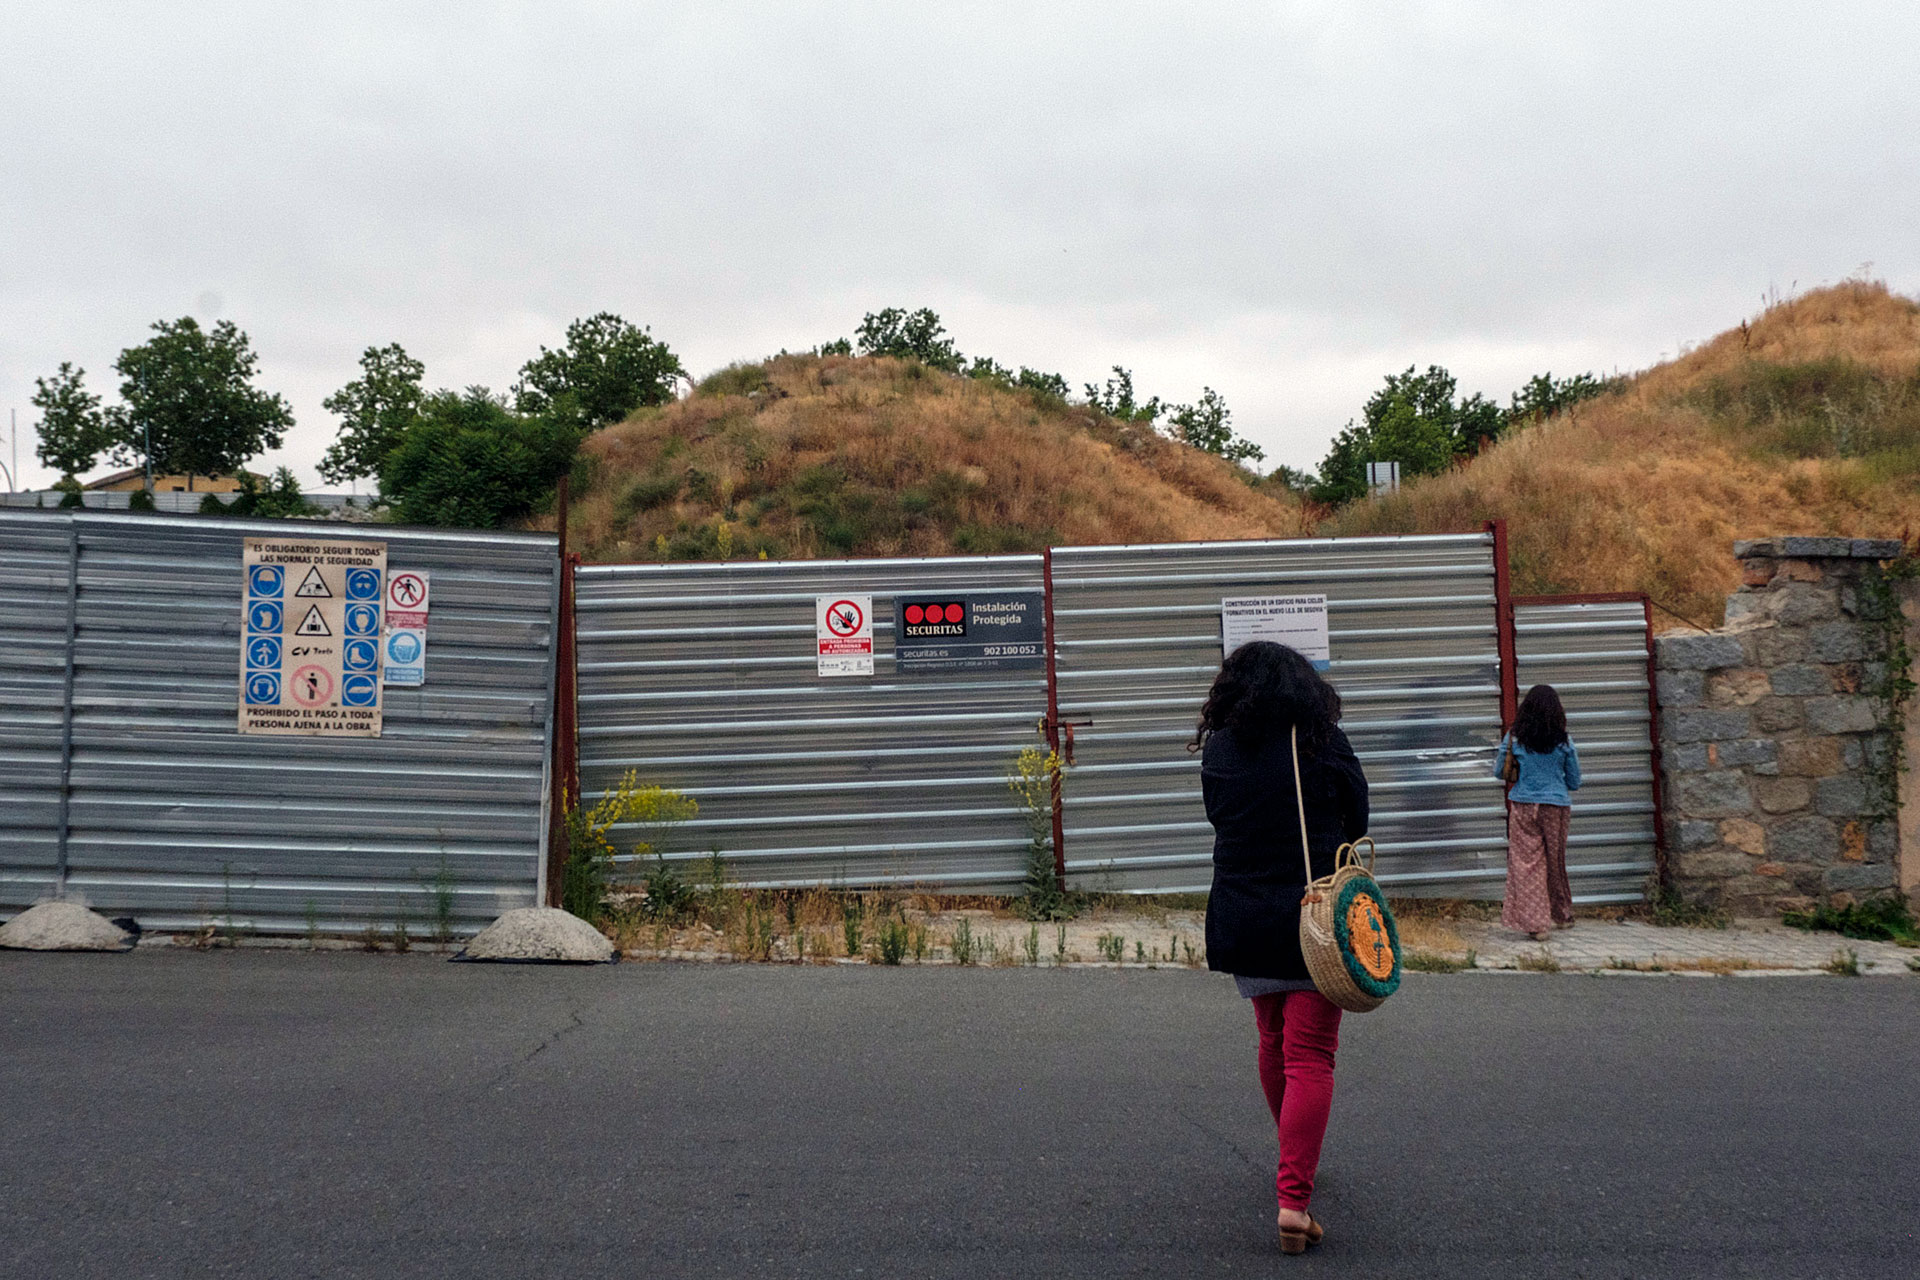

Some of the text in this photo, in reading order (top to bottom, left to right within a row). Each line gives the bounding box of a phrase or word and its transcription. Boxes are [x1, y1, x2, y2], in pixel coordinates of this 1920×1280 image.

[254, 544, 380, 556] ES OBLIGATORIO SEGUIR TODAS
[260, 555, 373, 566] LAS NORMAS DE SEGURIDAD
[972, 602, 1026, 612] Instalación
[973, 614, 1022, 625] Protegida
[906, 625, 964, 635] SECURITAS
[291, 646, 310, 656] CV
[903, 646, 1036, 658] securitas.es 902 100 052
[247, 708, 374, 719] PROHIBIDO EL PASO A TODA
[249, 720, 371, 730] PERSONA AJENA A LA OBRA
